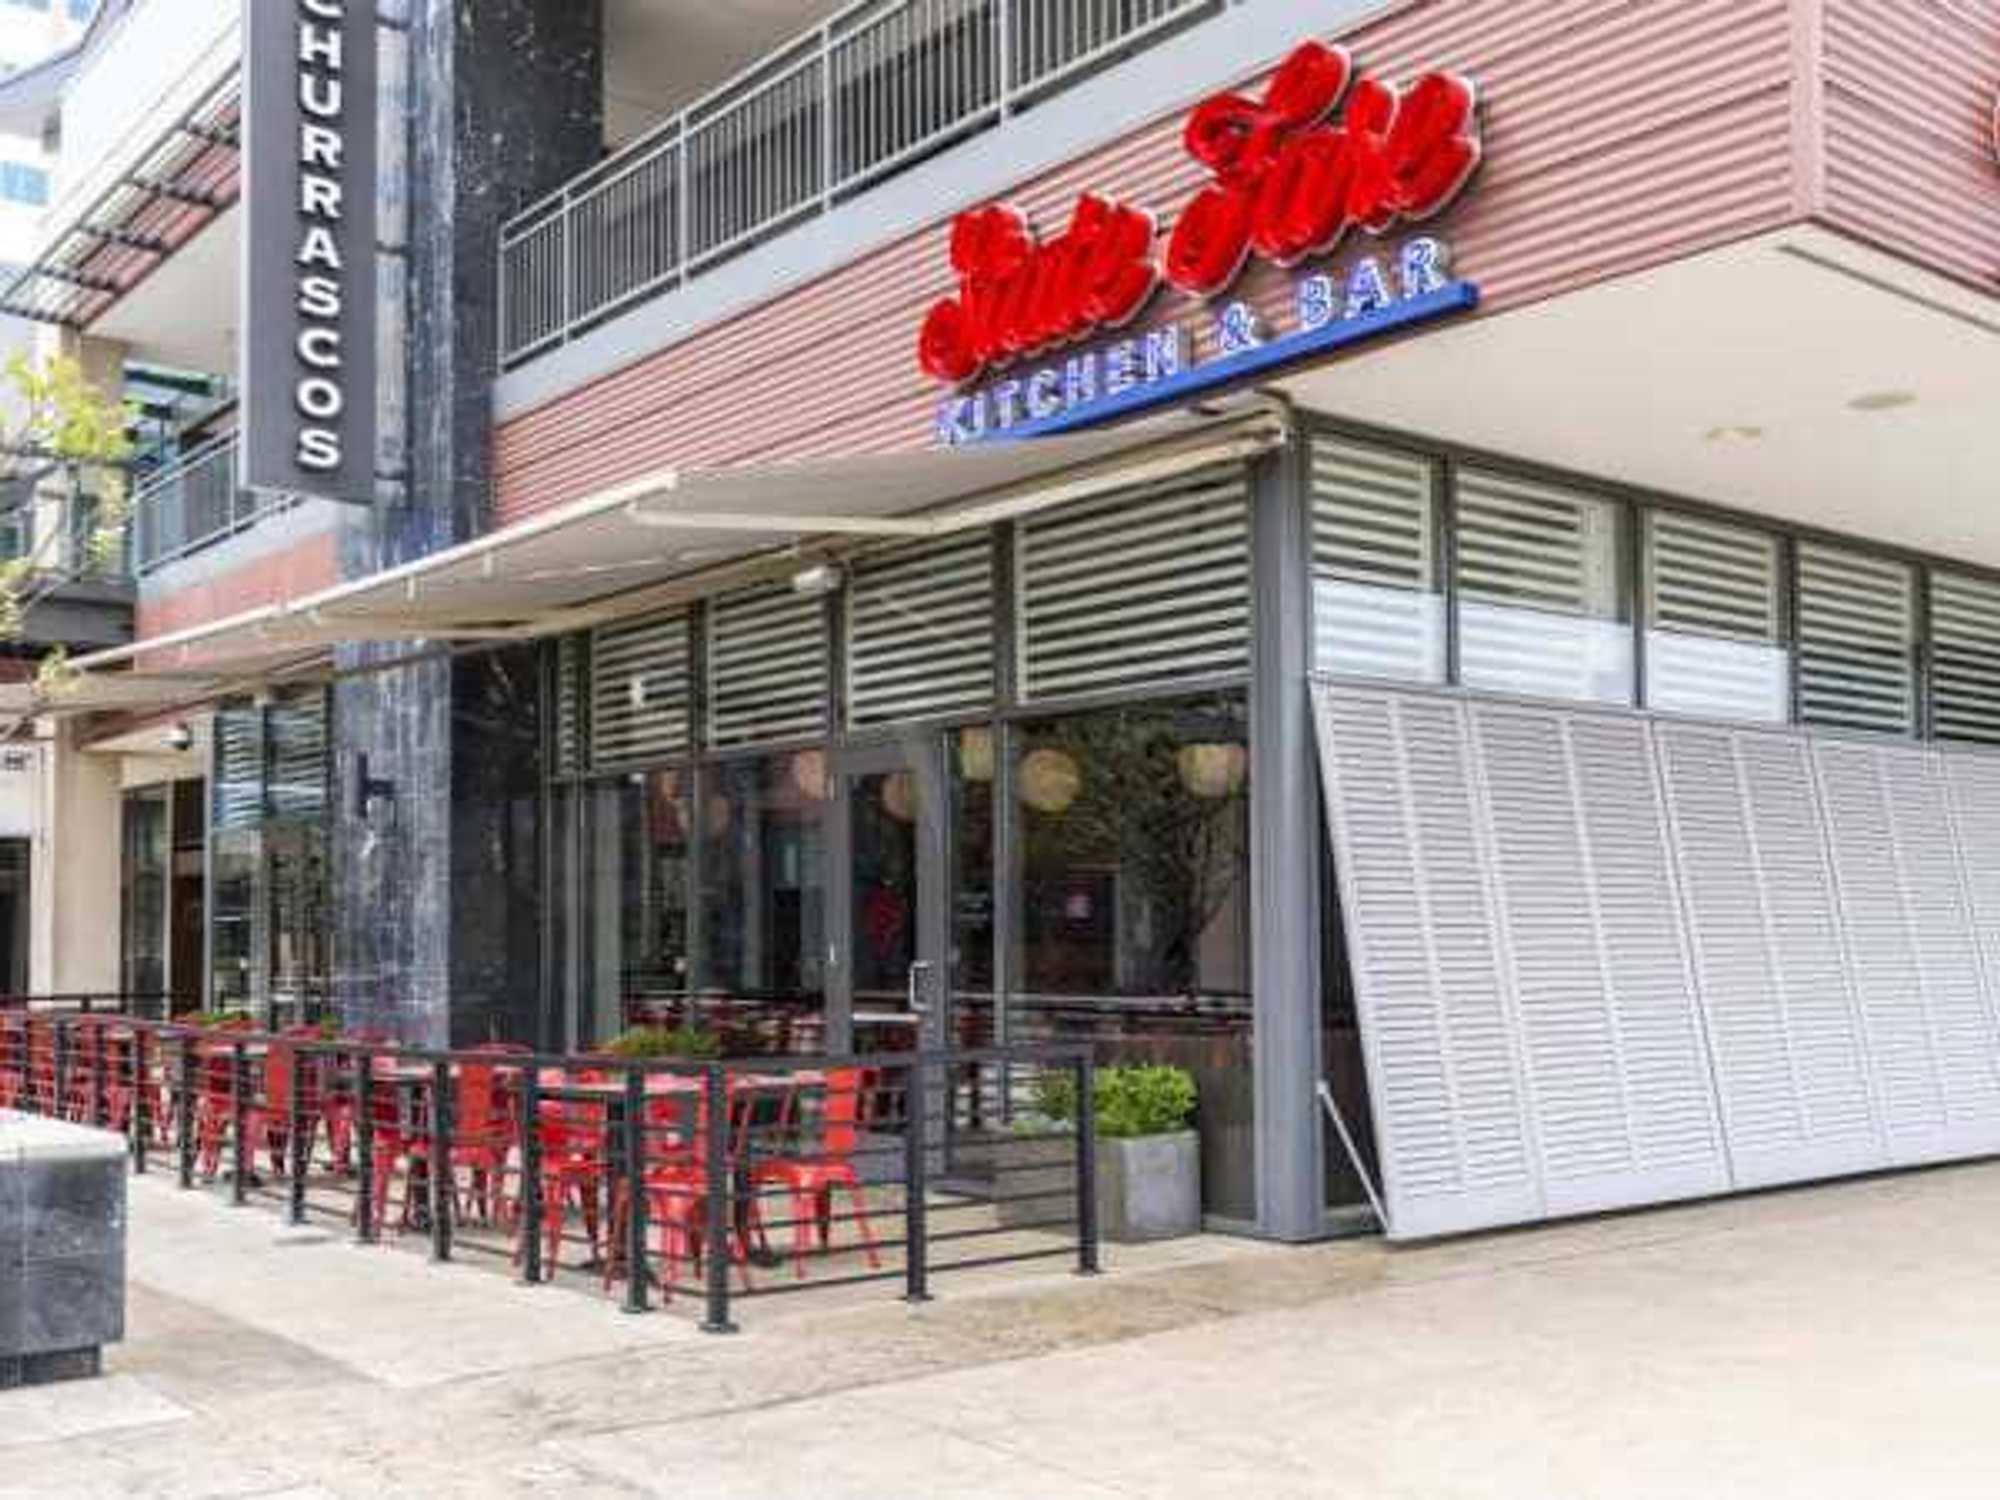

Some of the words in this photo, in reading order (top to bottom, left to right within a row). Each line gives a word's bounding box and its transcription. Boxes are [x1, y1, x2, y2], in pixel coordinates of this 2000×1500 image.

[936, 321, 1180, 444] KITCHEN
[1219, 302, 1264, 351] &
[1298, 237, 1448, 332] BAR
